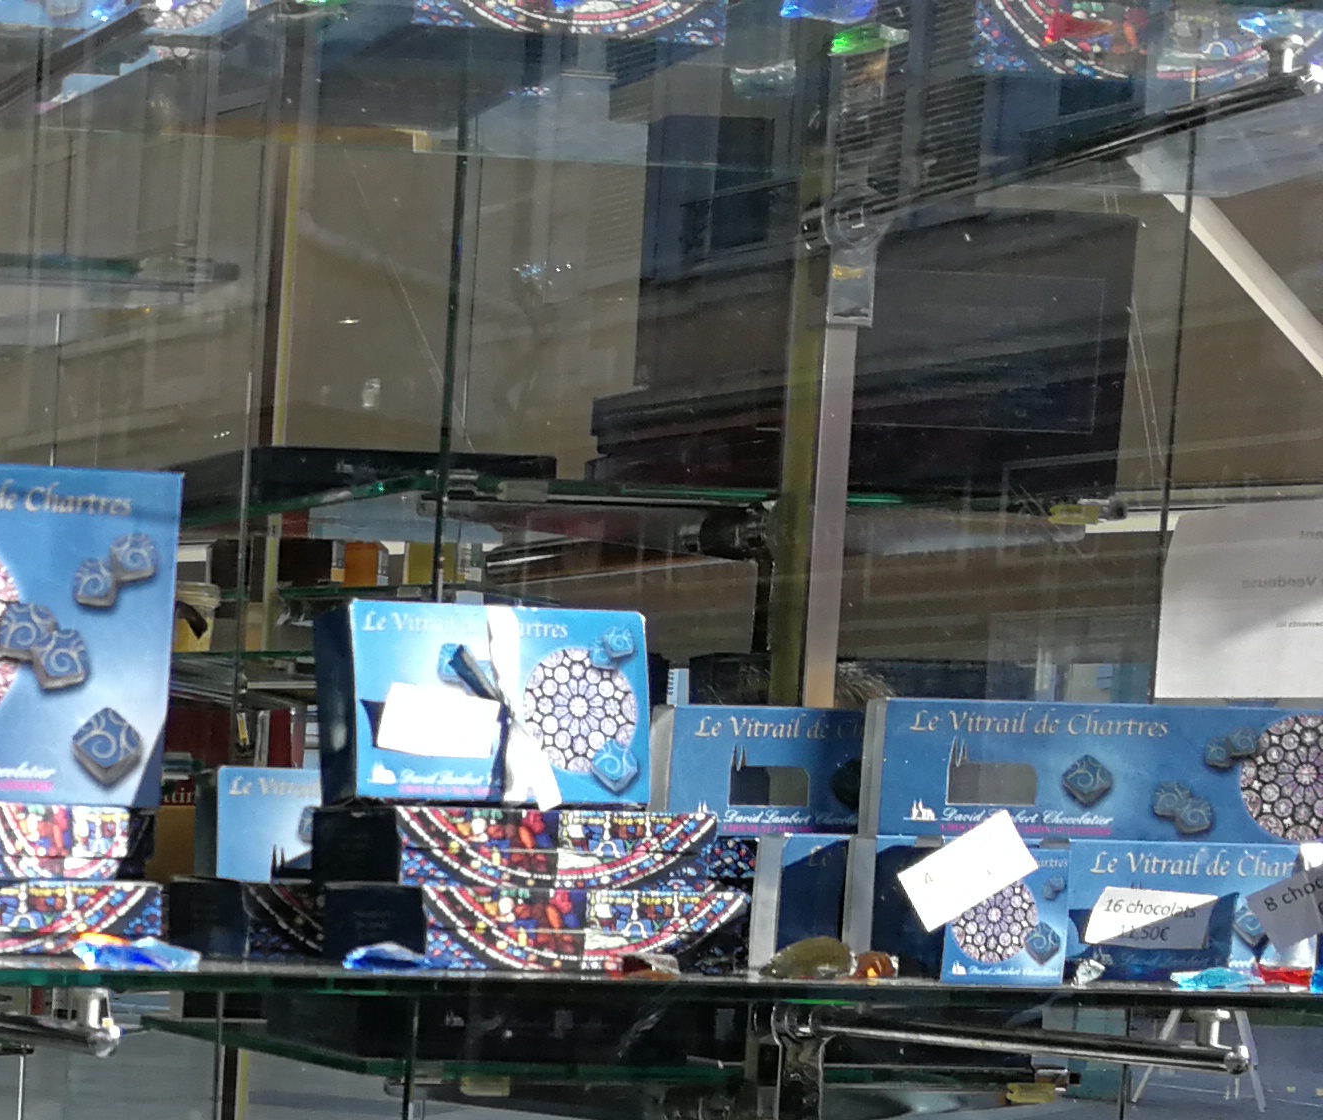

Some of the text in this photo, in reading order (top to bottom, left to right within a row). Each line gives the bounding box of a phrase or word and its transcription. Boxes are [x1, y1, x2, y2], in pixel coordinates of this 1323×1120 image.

[24, 481, 134, 516] Chartres
[362, 608, 387, 632] Le
[695, 715, 722, 738] Le
[730, 713, 806, 739] Vitrail
[909, 706, 1170, 737] Le Vitrail de Chartres
[229, 775, 252, 797] Le
[723, 809, 810, 825] David Lambert
[941, 807, 986, 822] David
[1042, 810, 1115, 827] Chocolatier
[1090, 851, 1118, 874] Le
[1127, 849, 1206, 877] Vitrail
[1206, 850, 1231, 877] de
[1103, 898, 1197, 918] 16 chocolats
[1264, 898, 1278, 912] 8
